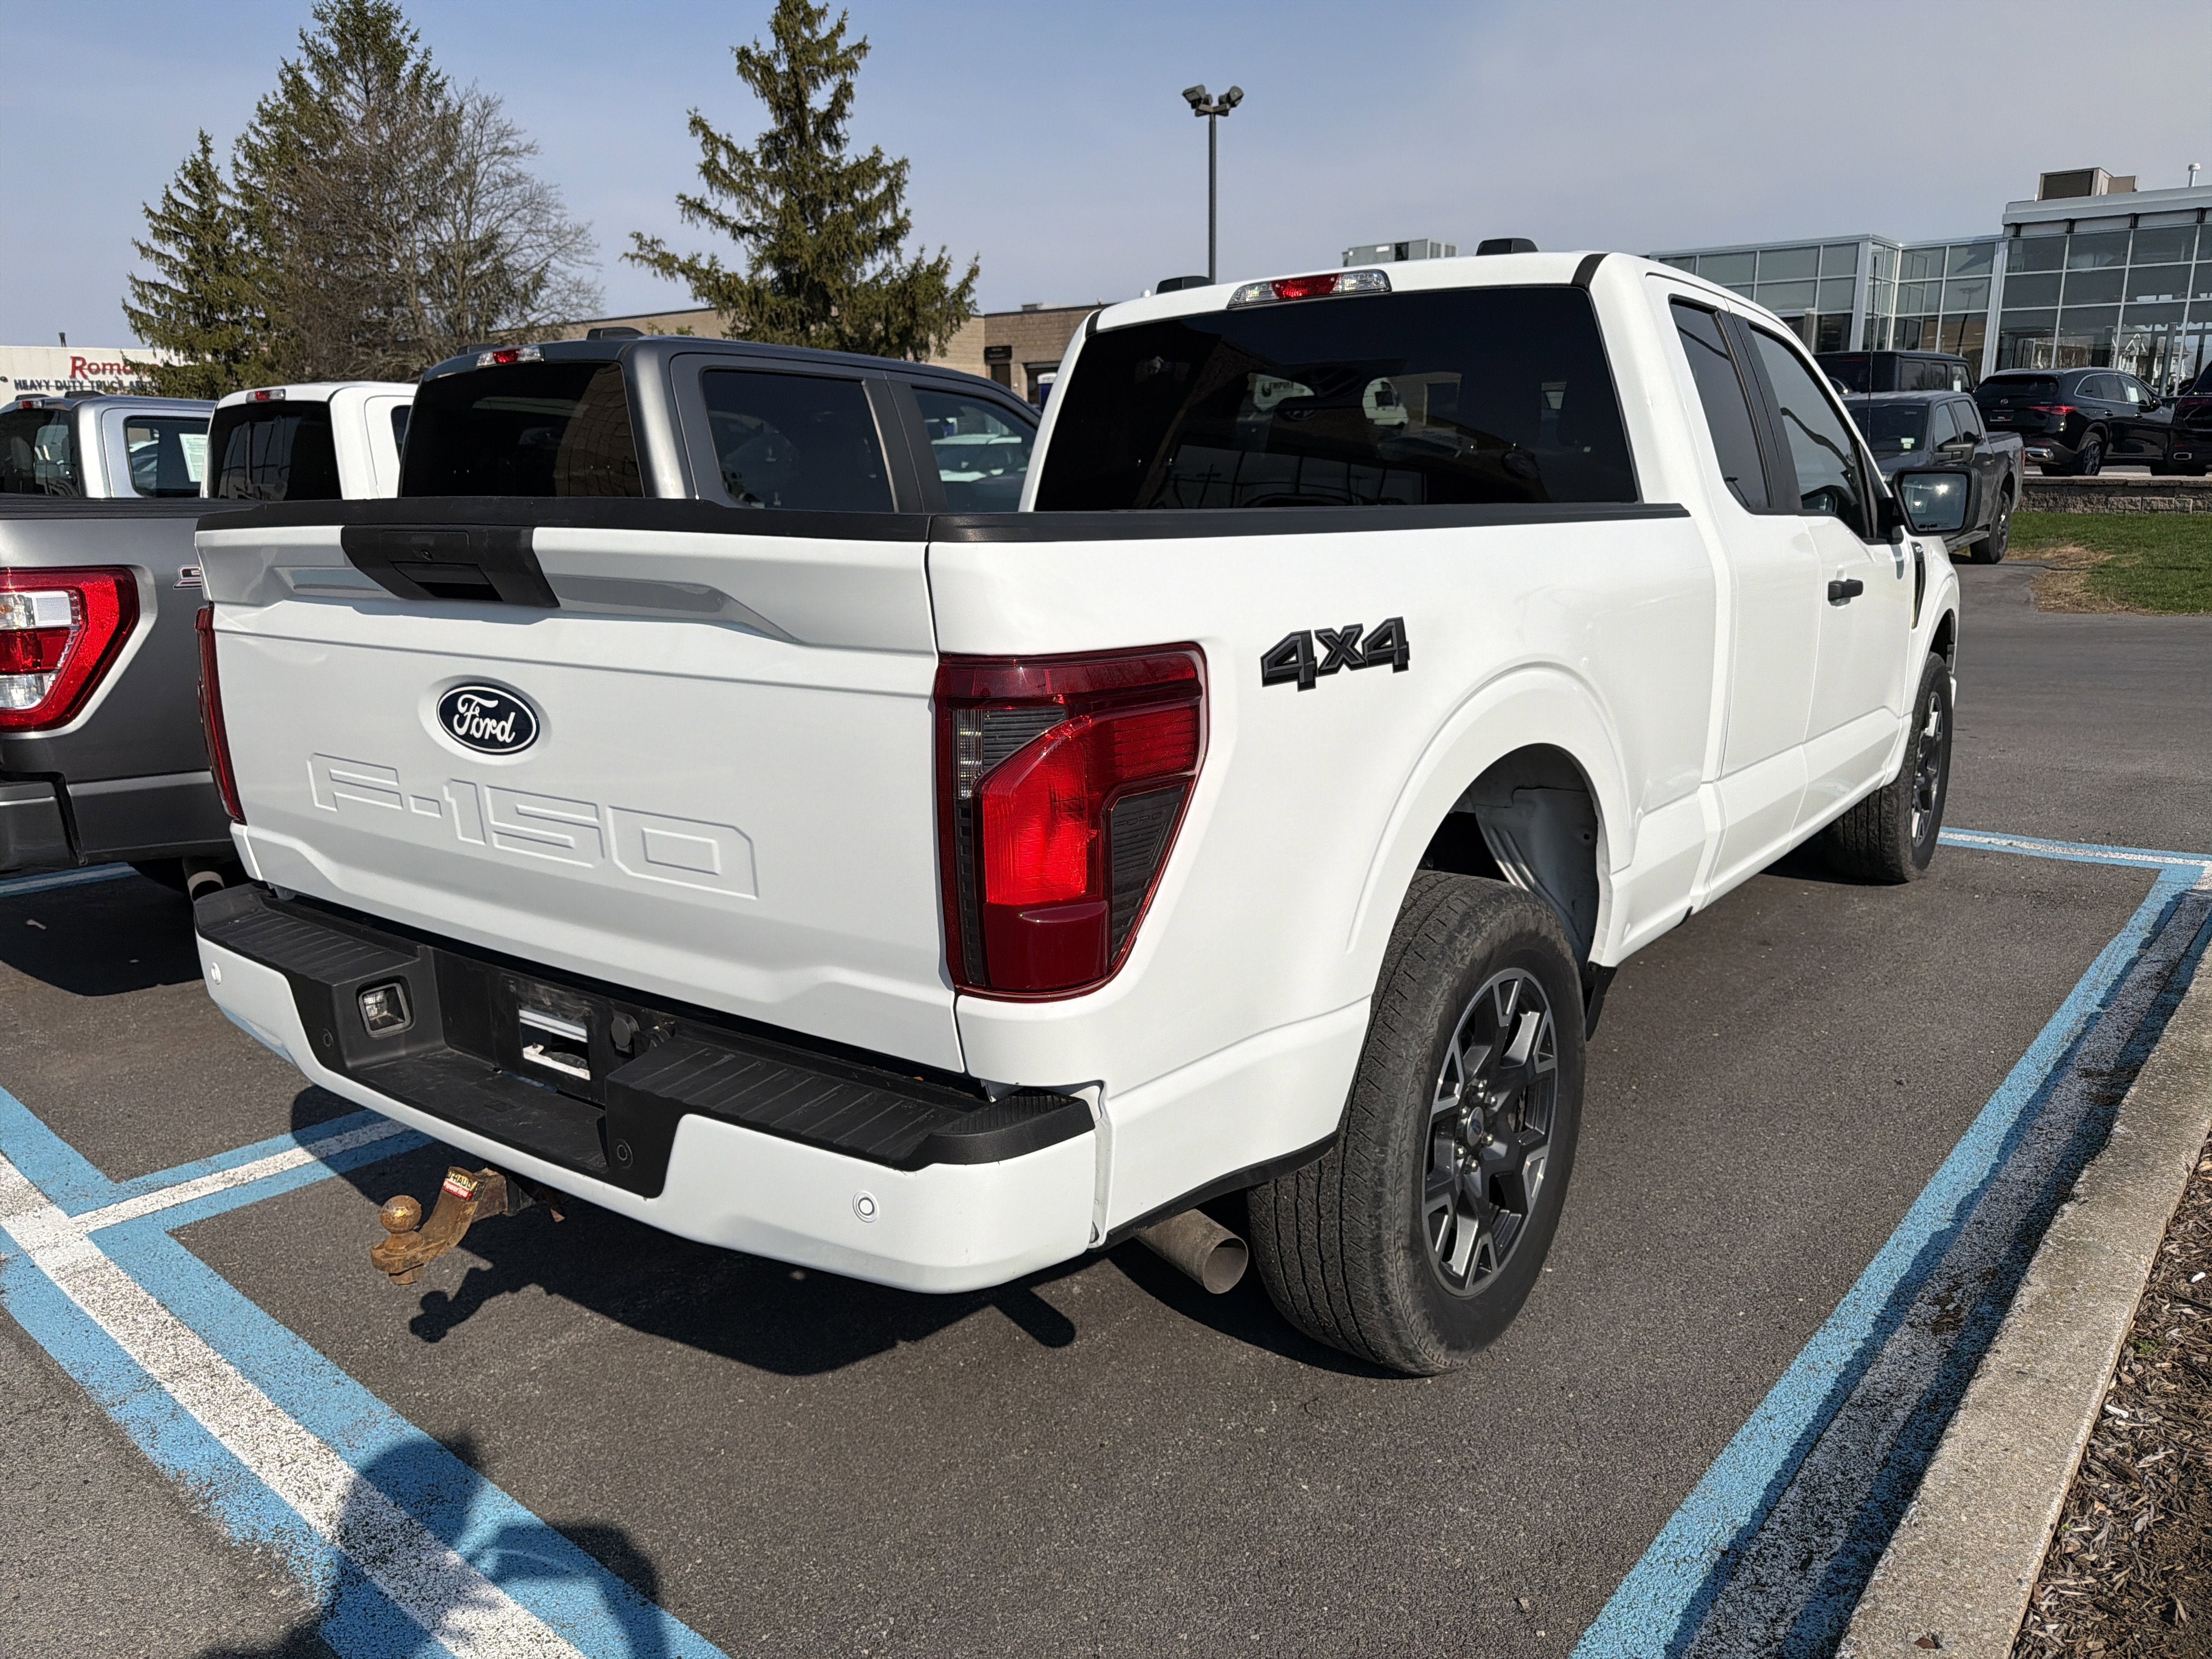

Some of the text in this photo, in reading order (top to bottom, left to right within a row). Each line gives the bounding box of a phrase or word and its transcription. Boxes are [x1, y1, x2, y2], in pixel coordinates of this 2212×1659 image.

[14, 379, 50, 391] HEAVY
[55, 379, 84, 391] DUTY
[453, 693, 516, 744] Ford
[307, 752, 759, 900] F-150
[1113, 812, 1163, 829] FORD
